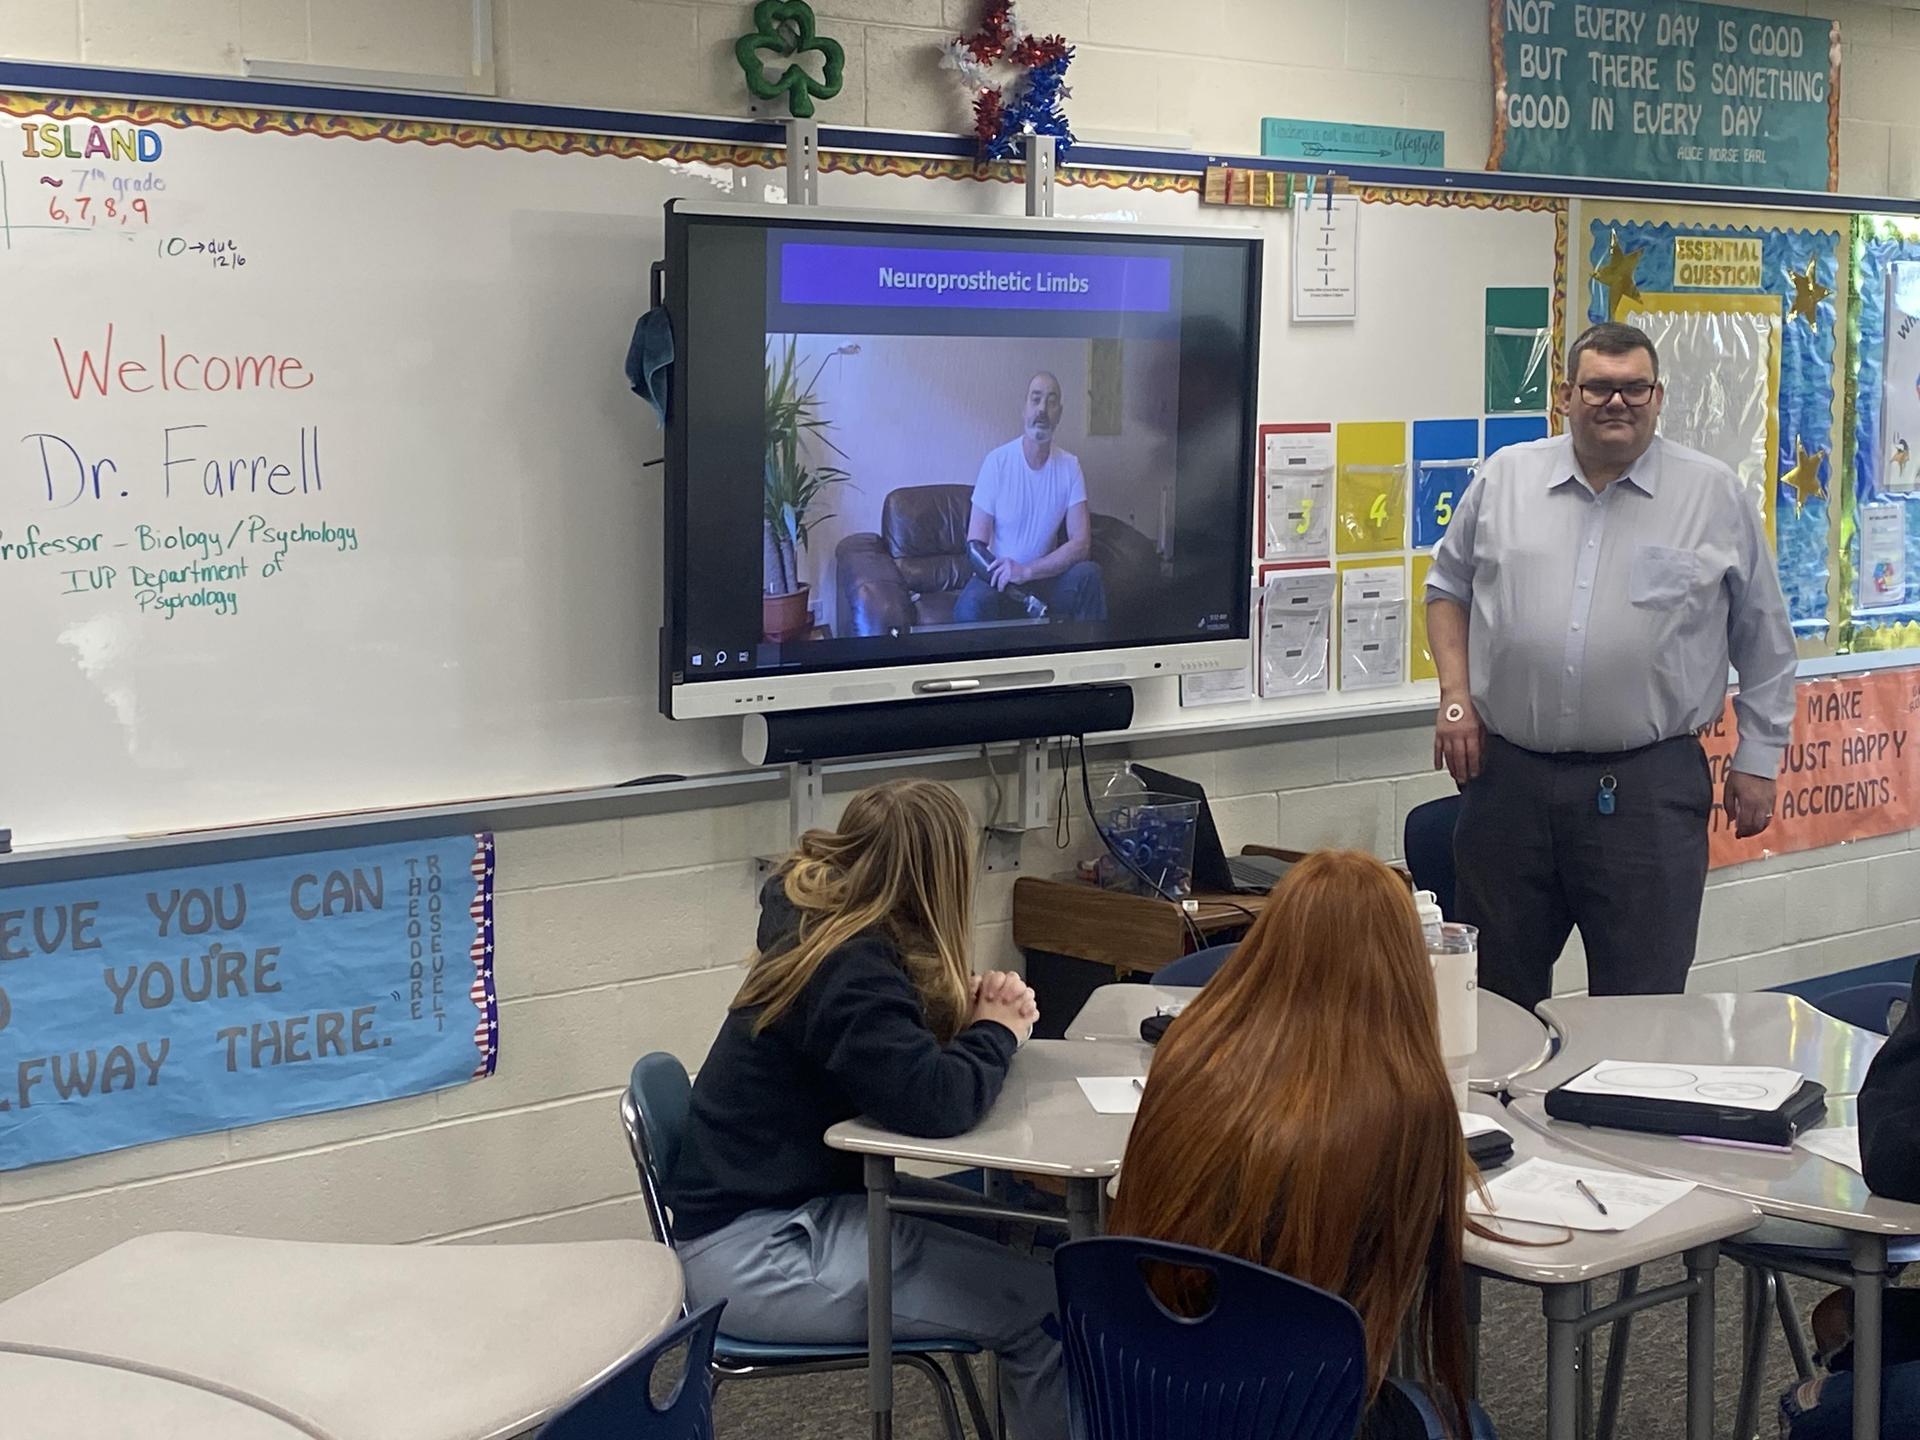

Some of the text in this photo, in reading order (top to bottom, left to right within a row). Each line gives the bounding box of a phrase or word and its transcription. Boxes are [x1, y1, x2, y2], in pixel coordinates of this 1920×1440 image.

[1506, 0, 1803, 58] NOT EVERY DAY IS GOOD
[1520, 44, 1824, 104] BUT THERE IS SOMETHING
[1507, 93, 1769, 138] GOOD IN EVERY DAY.
[21, 123, 162, 162] ISLAND
[1394, 131, 1440, 166] lifestyle
[112, 172, 166, 202] grade
[208, 239, 237, 255] due
[212, 255, 247, 269] 12/6
[1677, 239, 1760, 262] ESSENTIAL
[879, 267, 1089, 294] Neuroprosthetic Limbs
[1680, 263, 1761, 287] QUESTION
[53, 323, 314, 400] Welcome
[21, 425, 322, 511] Dr. Farrell
[1369, 493, 1388, 528] 4
[1435, 491, 1453, 526] 5
[0, 523, 103, 561] rofessor
[61, 551, 285, 595] IUP Department of
[1807, 691, 1864, 723] MAKE
[1780, 730, 1908, 775] JUST HAPPY
[1782, 776, 1897, 820] ACCIDENTS.
[146, 882, 248, 937] YOU
[290, 865, 384, 920] CAN
[405, 858, 423, 1020] THEODORE
[426, 854, 447, 1032] ROOSEVELT
[103, 942, 282, 1015] YOU'RE
[0, 1037, 171, 1112] FWAY
